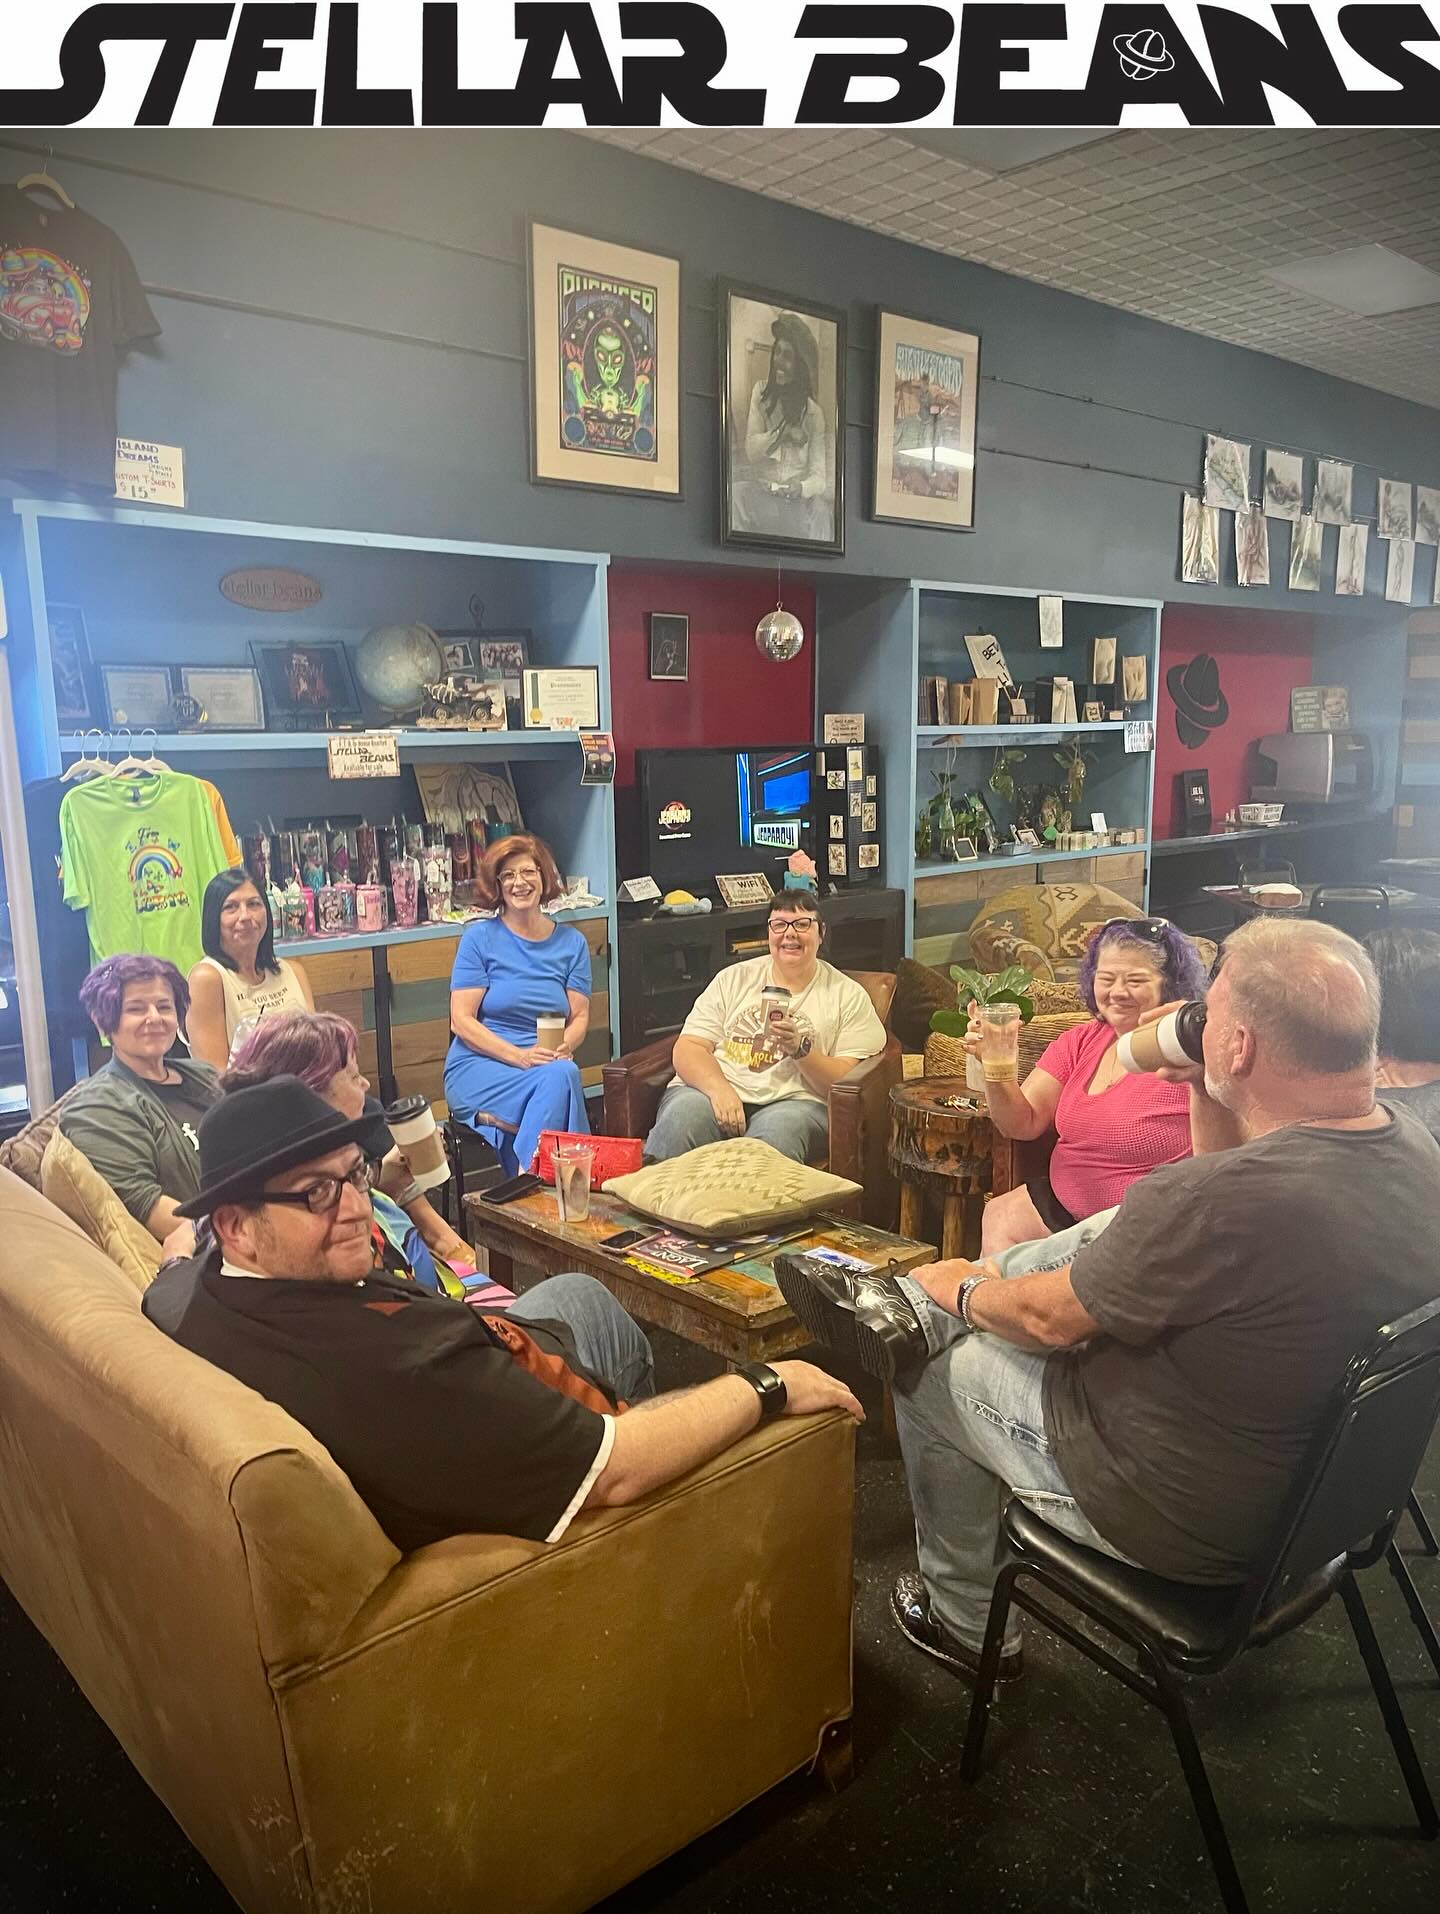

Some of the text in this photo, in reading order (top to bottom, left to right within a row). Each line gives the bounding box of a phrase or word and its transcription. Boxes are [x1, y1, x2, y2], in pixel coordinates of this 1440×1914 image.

[117, 440, 159, 453] ISLAND
[117, 450, 160, 464] DREAMS
[333, 747, 371, 756] STELLAR
[359, 754, 395, 763] BEANS
[658, 809, 691, 825] JEOPARDY!
[756, 826, 795, 846] JEOPARDY!
